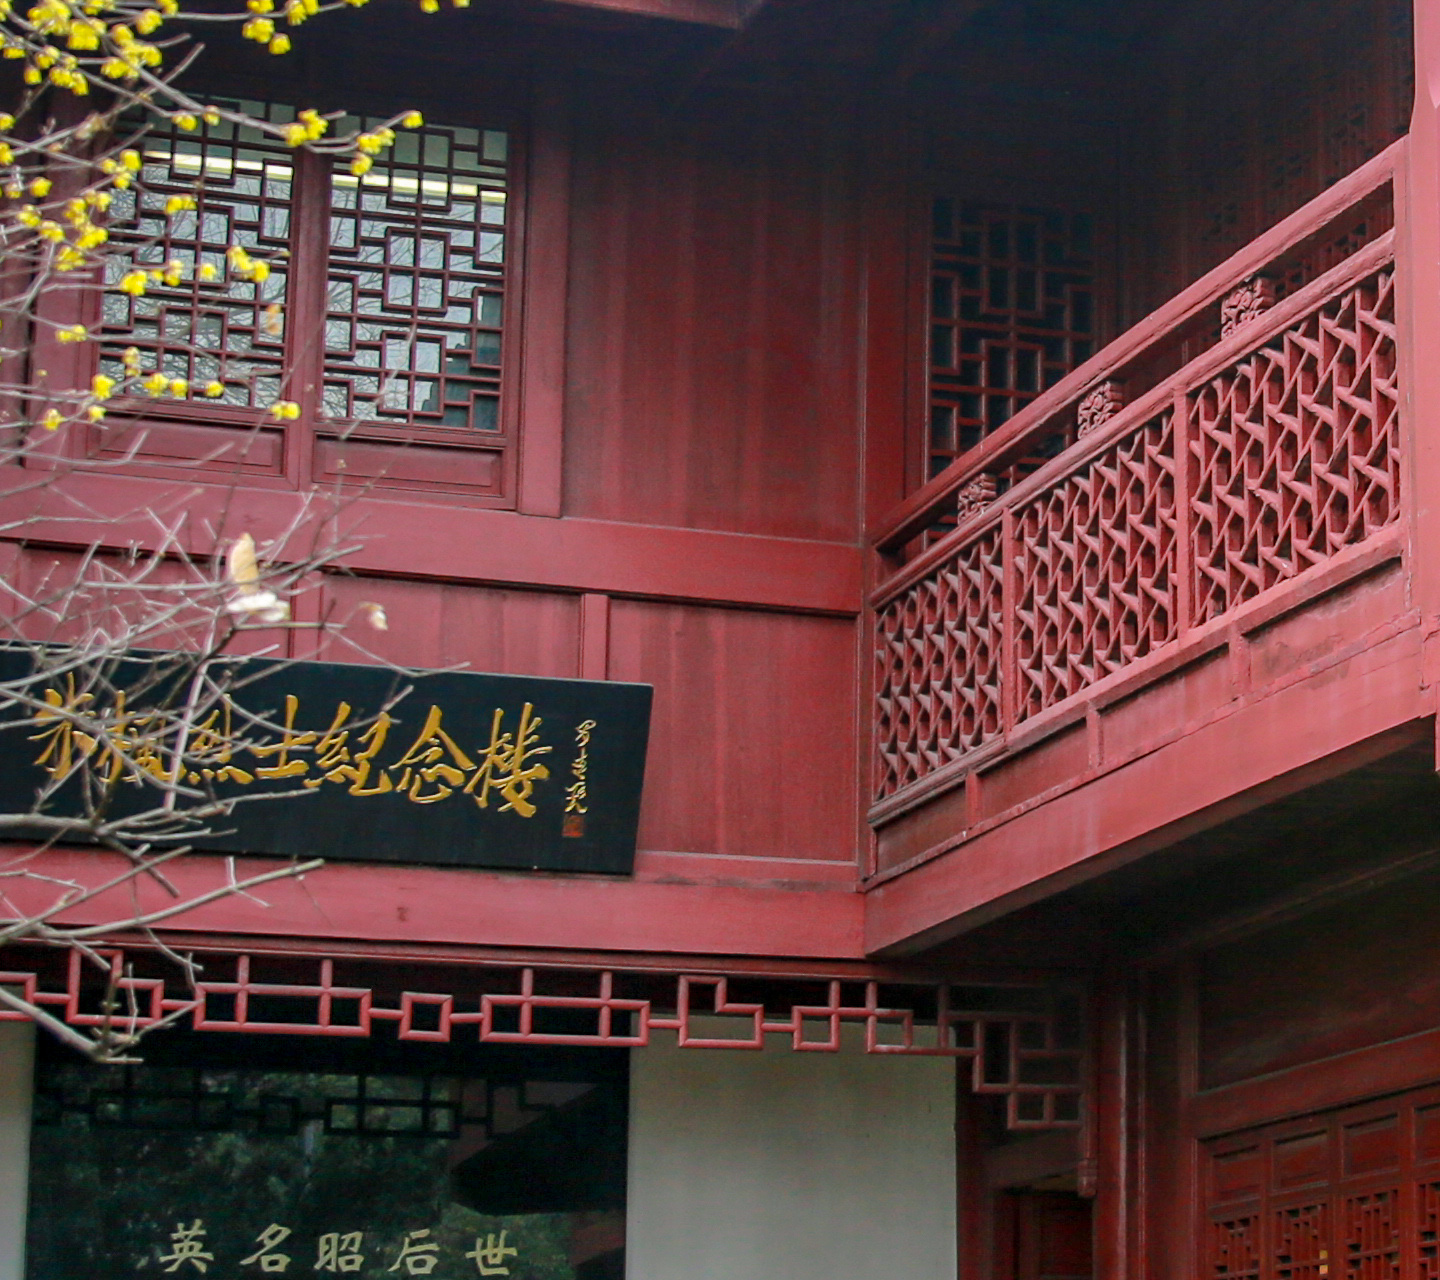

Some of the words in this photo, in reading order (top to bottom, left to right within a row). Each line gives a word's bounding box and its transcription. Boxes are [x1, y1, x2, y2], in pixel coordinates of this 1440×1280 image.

[160, 1219, 519, 1277] 英名昭后世
